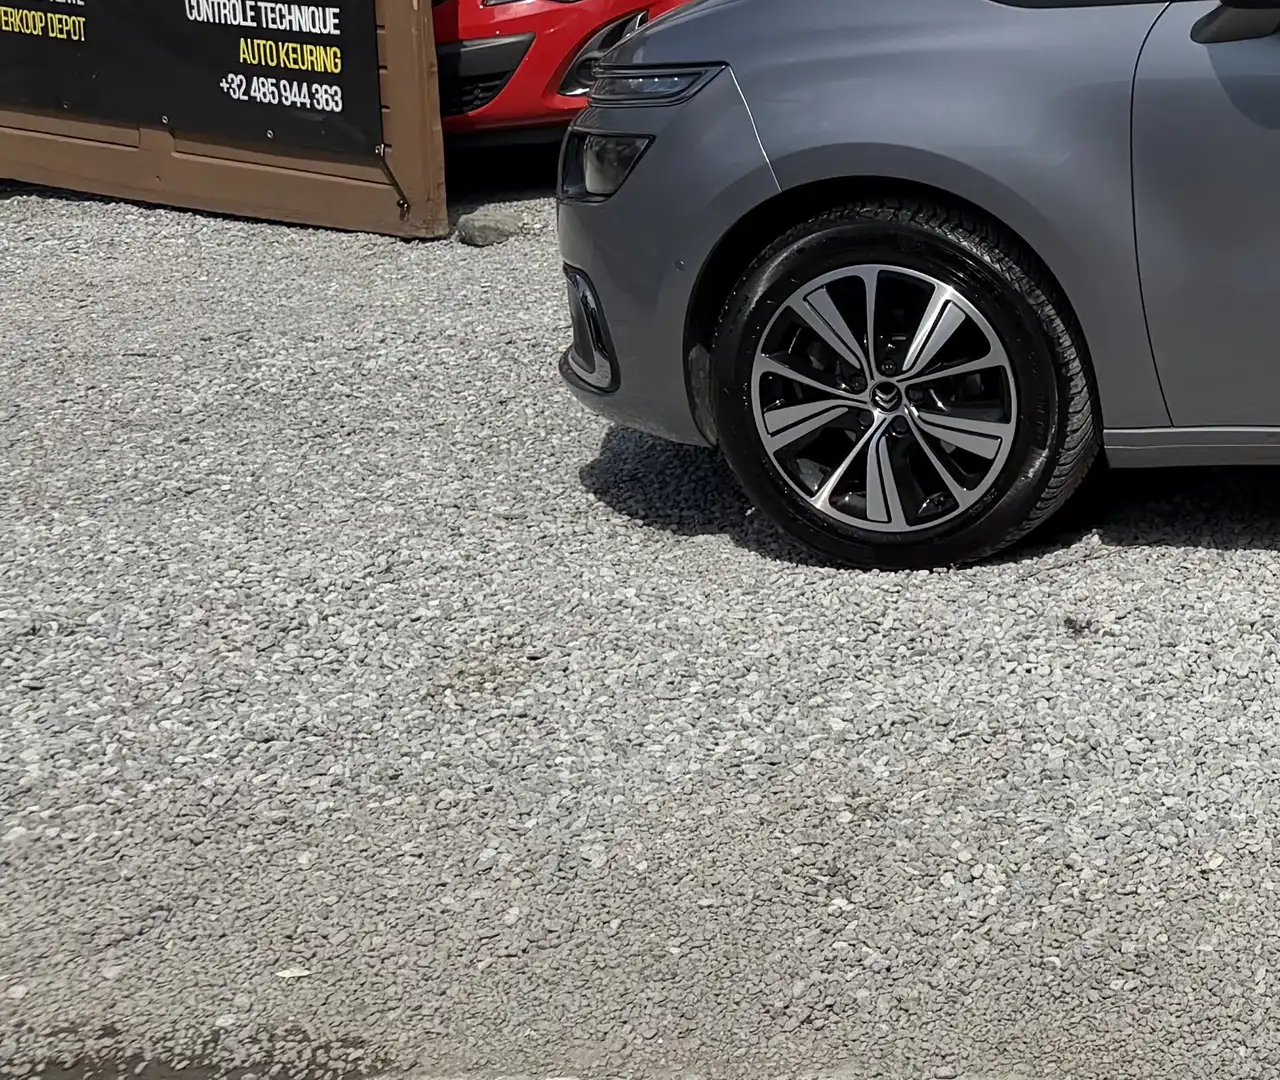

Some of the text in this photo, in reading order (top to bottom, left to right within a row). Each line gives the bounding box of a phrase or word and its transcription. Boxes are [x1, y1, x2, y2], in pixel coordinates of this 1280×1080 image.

[0, 6, 86, 42] ERKOOP DEPOT
[257, 2, 341, 35] TECHNIQUE
[239, 37, 342, 74] AUTO KEURING
[219, 73, 343, 113] +32 485 944 363
